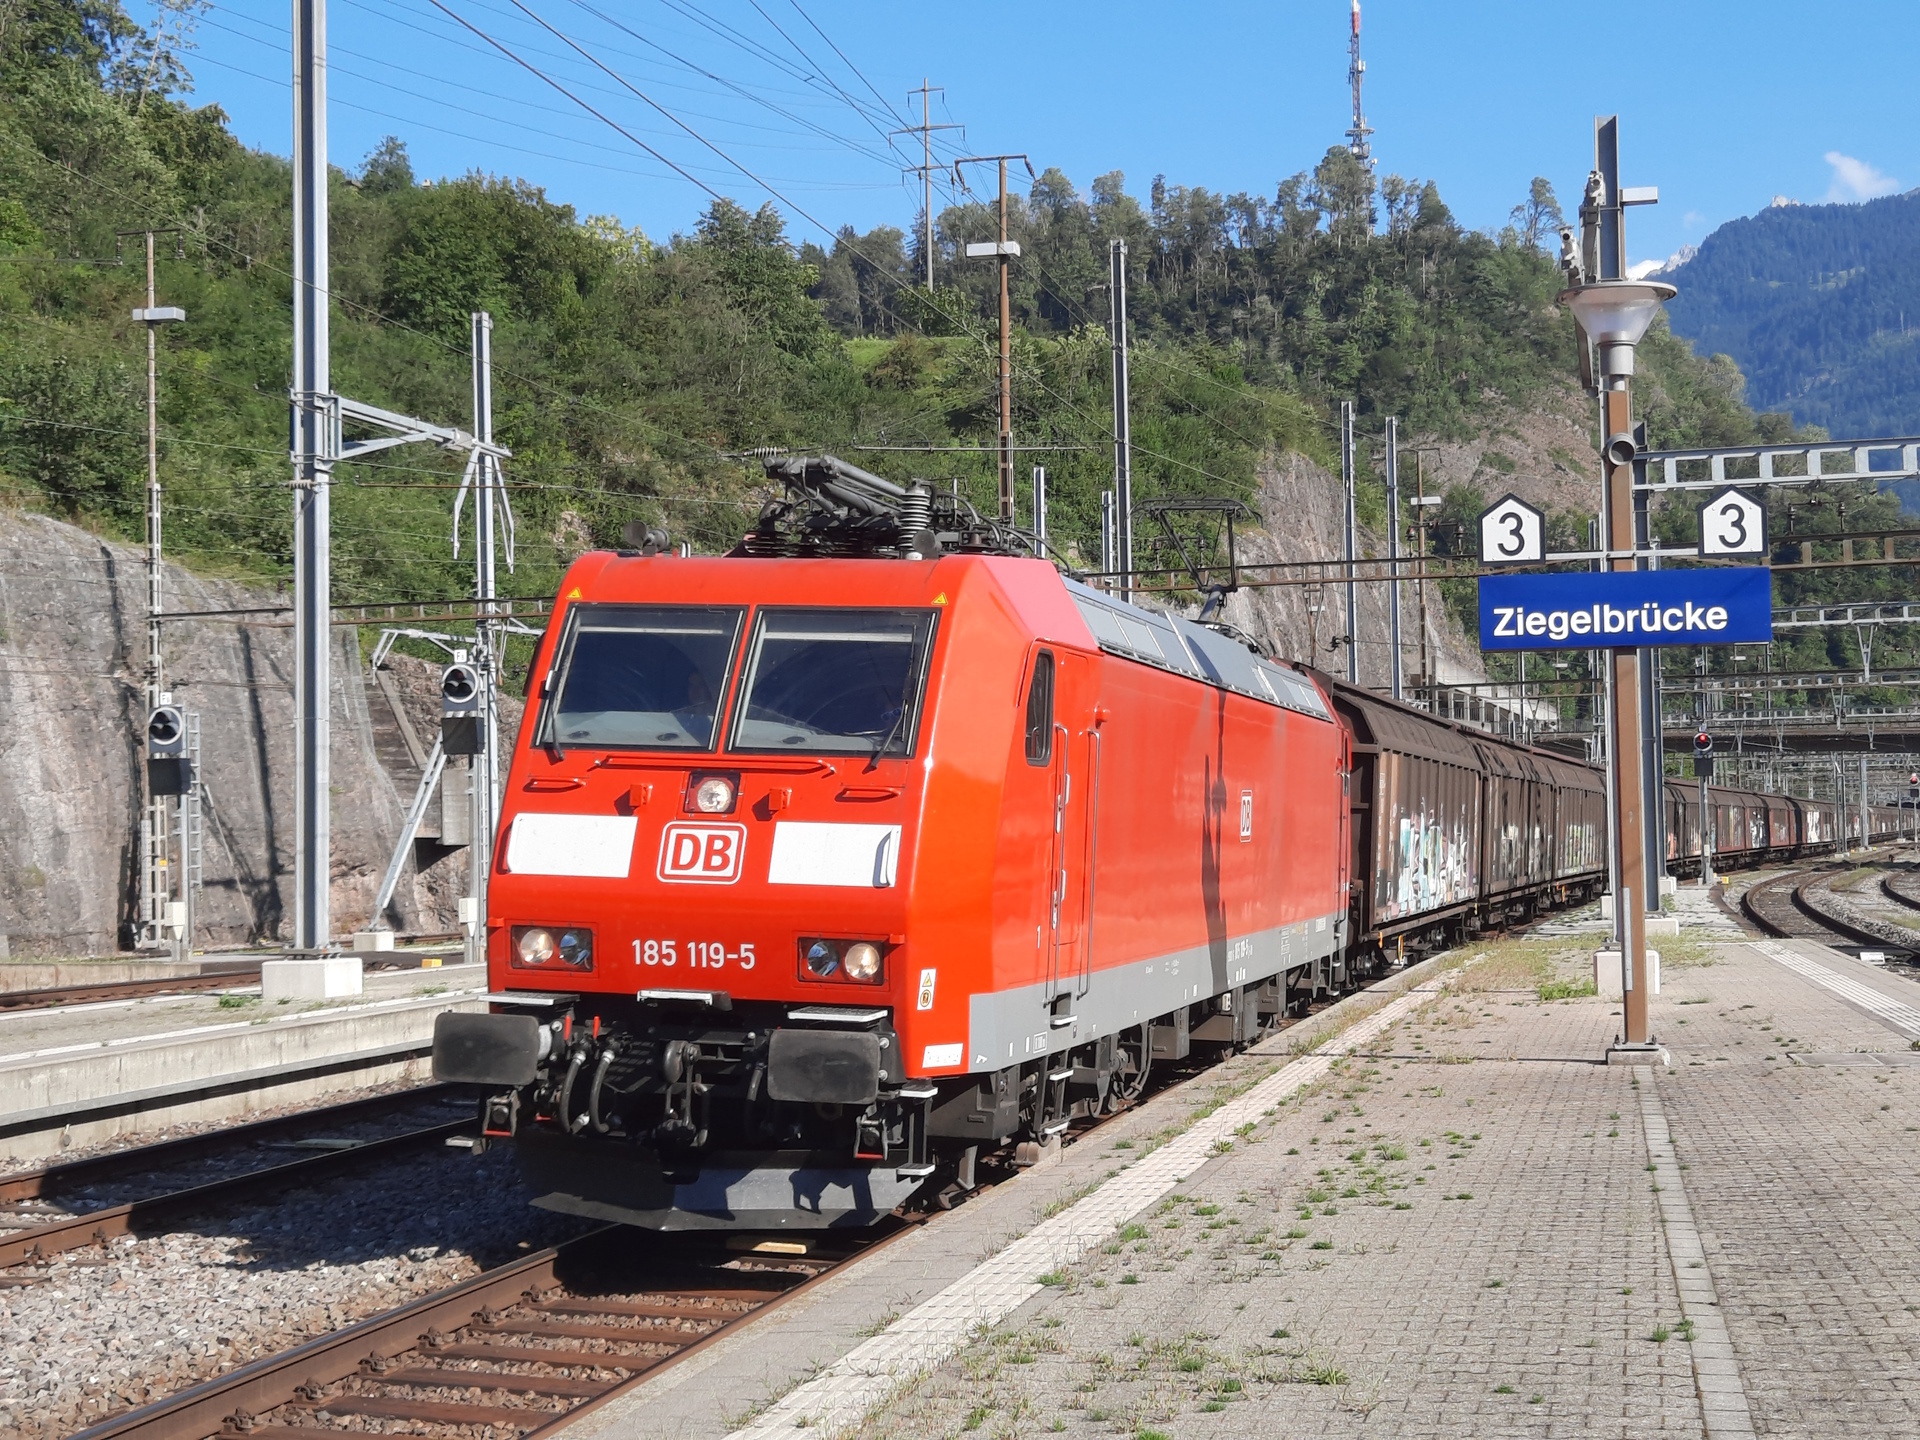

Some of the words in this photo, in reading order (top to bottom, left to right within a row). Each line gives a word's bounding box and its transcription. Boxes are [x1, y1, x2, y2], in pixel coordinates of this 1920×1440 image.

[1497, 512, 1525, 556] 3
[1718, 503, 1747, 548] 3
[1492, 601, 1728, 640] Ziegelbrücke
[1241, 799, 1251, 832] DB
[670, 833, 732, 872] DB
[631, 939, 677, 966] 185
[687, 941, 756, 970] 119-5
